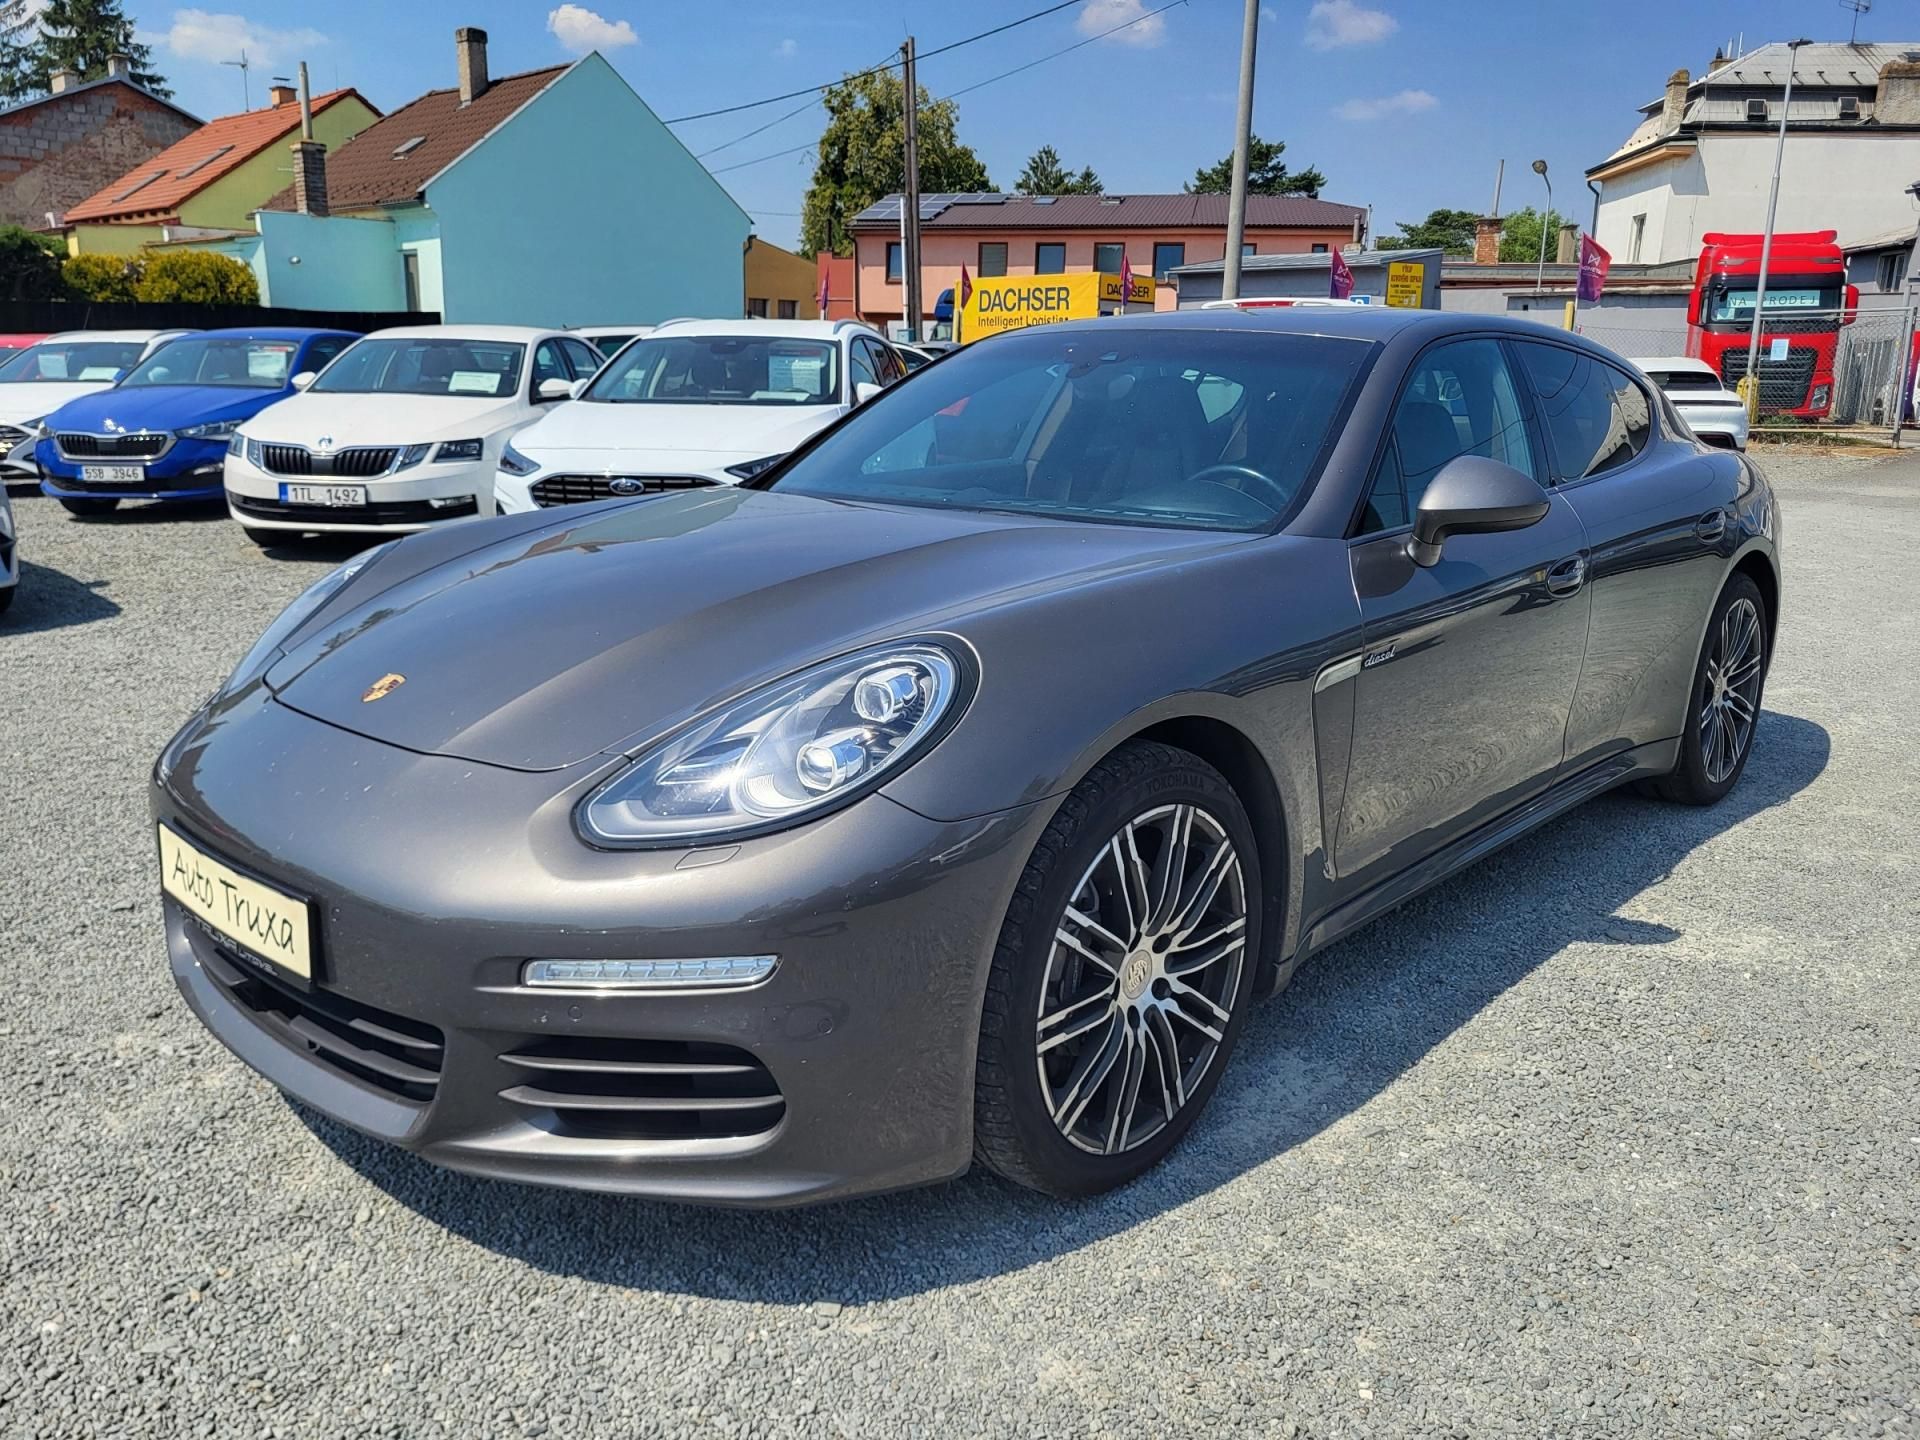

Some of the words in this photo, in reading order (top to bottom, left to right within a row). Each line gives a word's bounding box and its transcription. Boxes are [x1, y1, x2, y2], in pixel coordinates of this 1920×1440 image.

[1107, 283, 1150, 298] DACSER
[979, 286, 1070, 313] DACHSER
[1729, 297, 1747, 306] NA
[978, 315, 1023, 329] Intelligent
[1026, 315, 1069, 327] Logisti
[112, 468, 139, 479] 3946
[292, 487, 316, 501] 1TL
[326, 488, 359, 504] 1492
[1364, 645, 1396, 667] diesel
[1144, 774, 1206, 795] YOKOHAMA
[172, 847, 214, 909] Auto
[219, 877, 295, 954] Truxa
